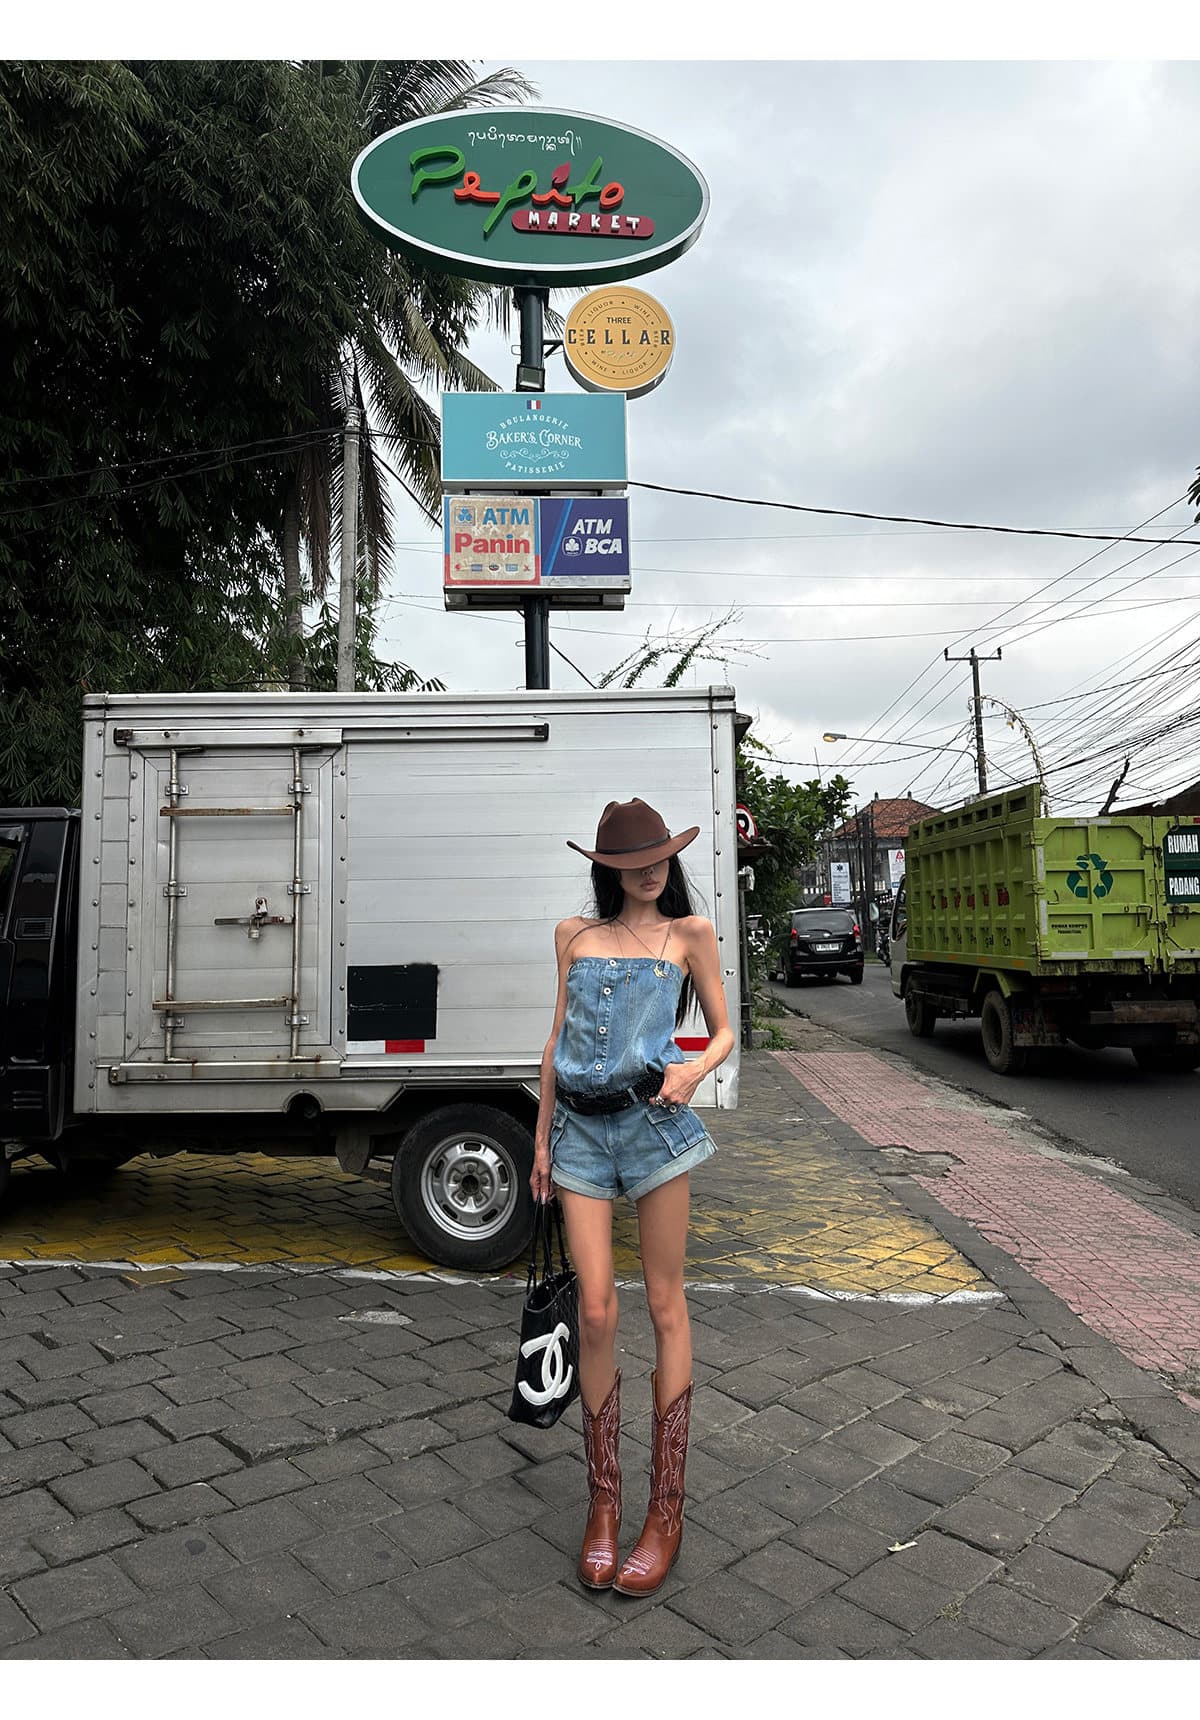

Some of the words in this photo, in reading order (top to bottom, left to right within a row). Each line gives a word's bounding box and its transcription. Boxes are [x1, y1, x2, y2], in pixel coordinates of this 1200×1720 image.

[409, 145, 625, 235] Pepito
[528, 211, 640, 231] MARKET
[607, 316, 632, 324] THREE
[567, 328, 671, 345] CELLAR
[499, 414, 569, 430] BOULANGERIE
[505, 461, 566, 474] PATISSERIE
[482, 508, 530, 526] ATM
[571, 518, 613, 535] ATM
[454, 533, 531, 554] Panin
[584, 538, 623, 555] BCA
[1167, 834, 1199, 854] RUMAH
[1168, 876, 1200, 897] PADANG
